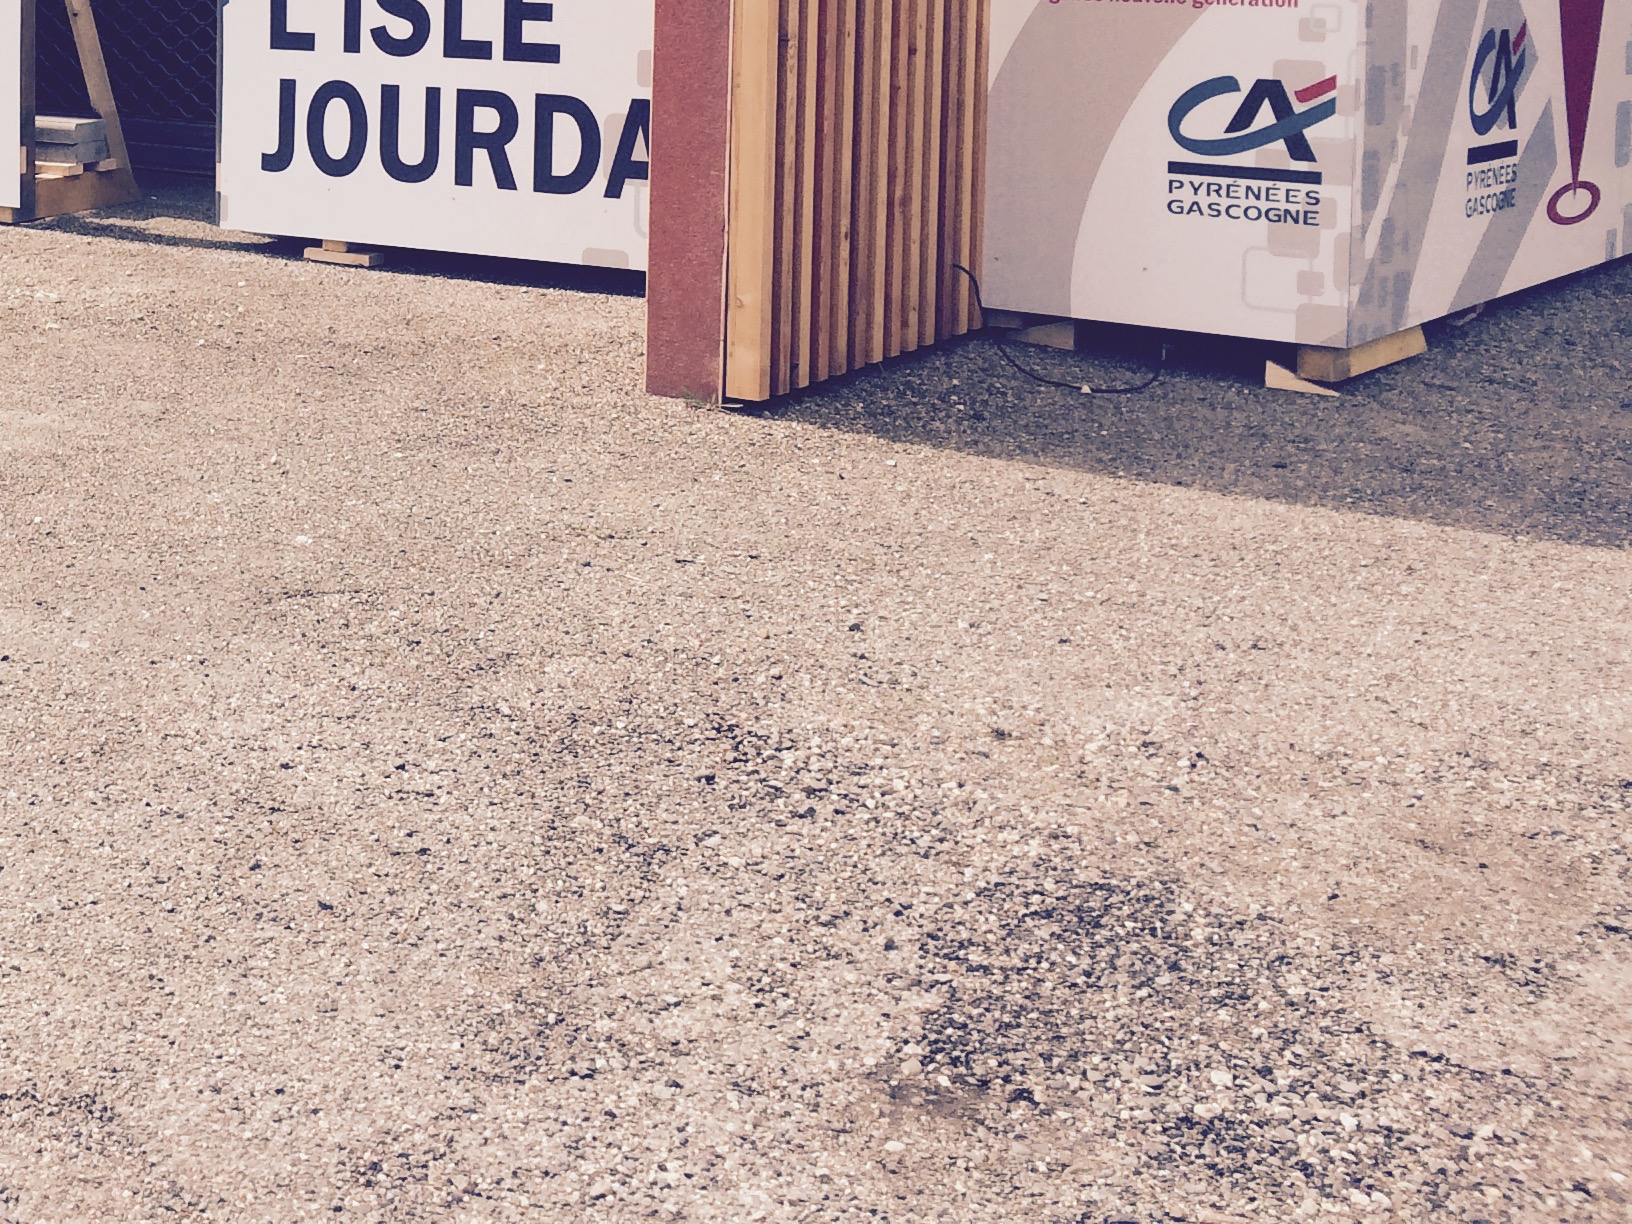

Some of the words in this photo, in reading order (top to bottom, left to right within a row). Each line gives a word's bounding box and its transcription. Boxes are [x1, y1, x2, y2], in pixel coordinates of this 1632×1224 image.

[261, 78, 651, 199] JOURDA
[1466, 162, 1518, 192] PYRÉNÉES
[1168, 179, 1321, 206] PYRÉNÉES
[1465, 187, 1517, 218] GASCOGNE
[1167, 199, 1320, 226] GASCOGNE
